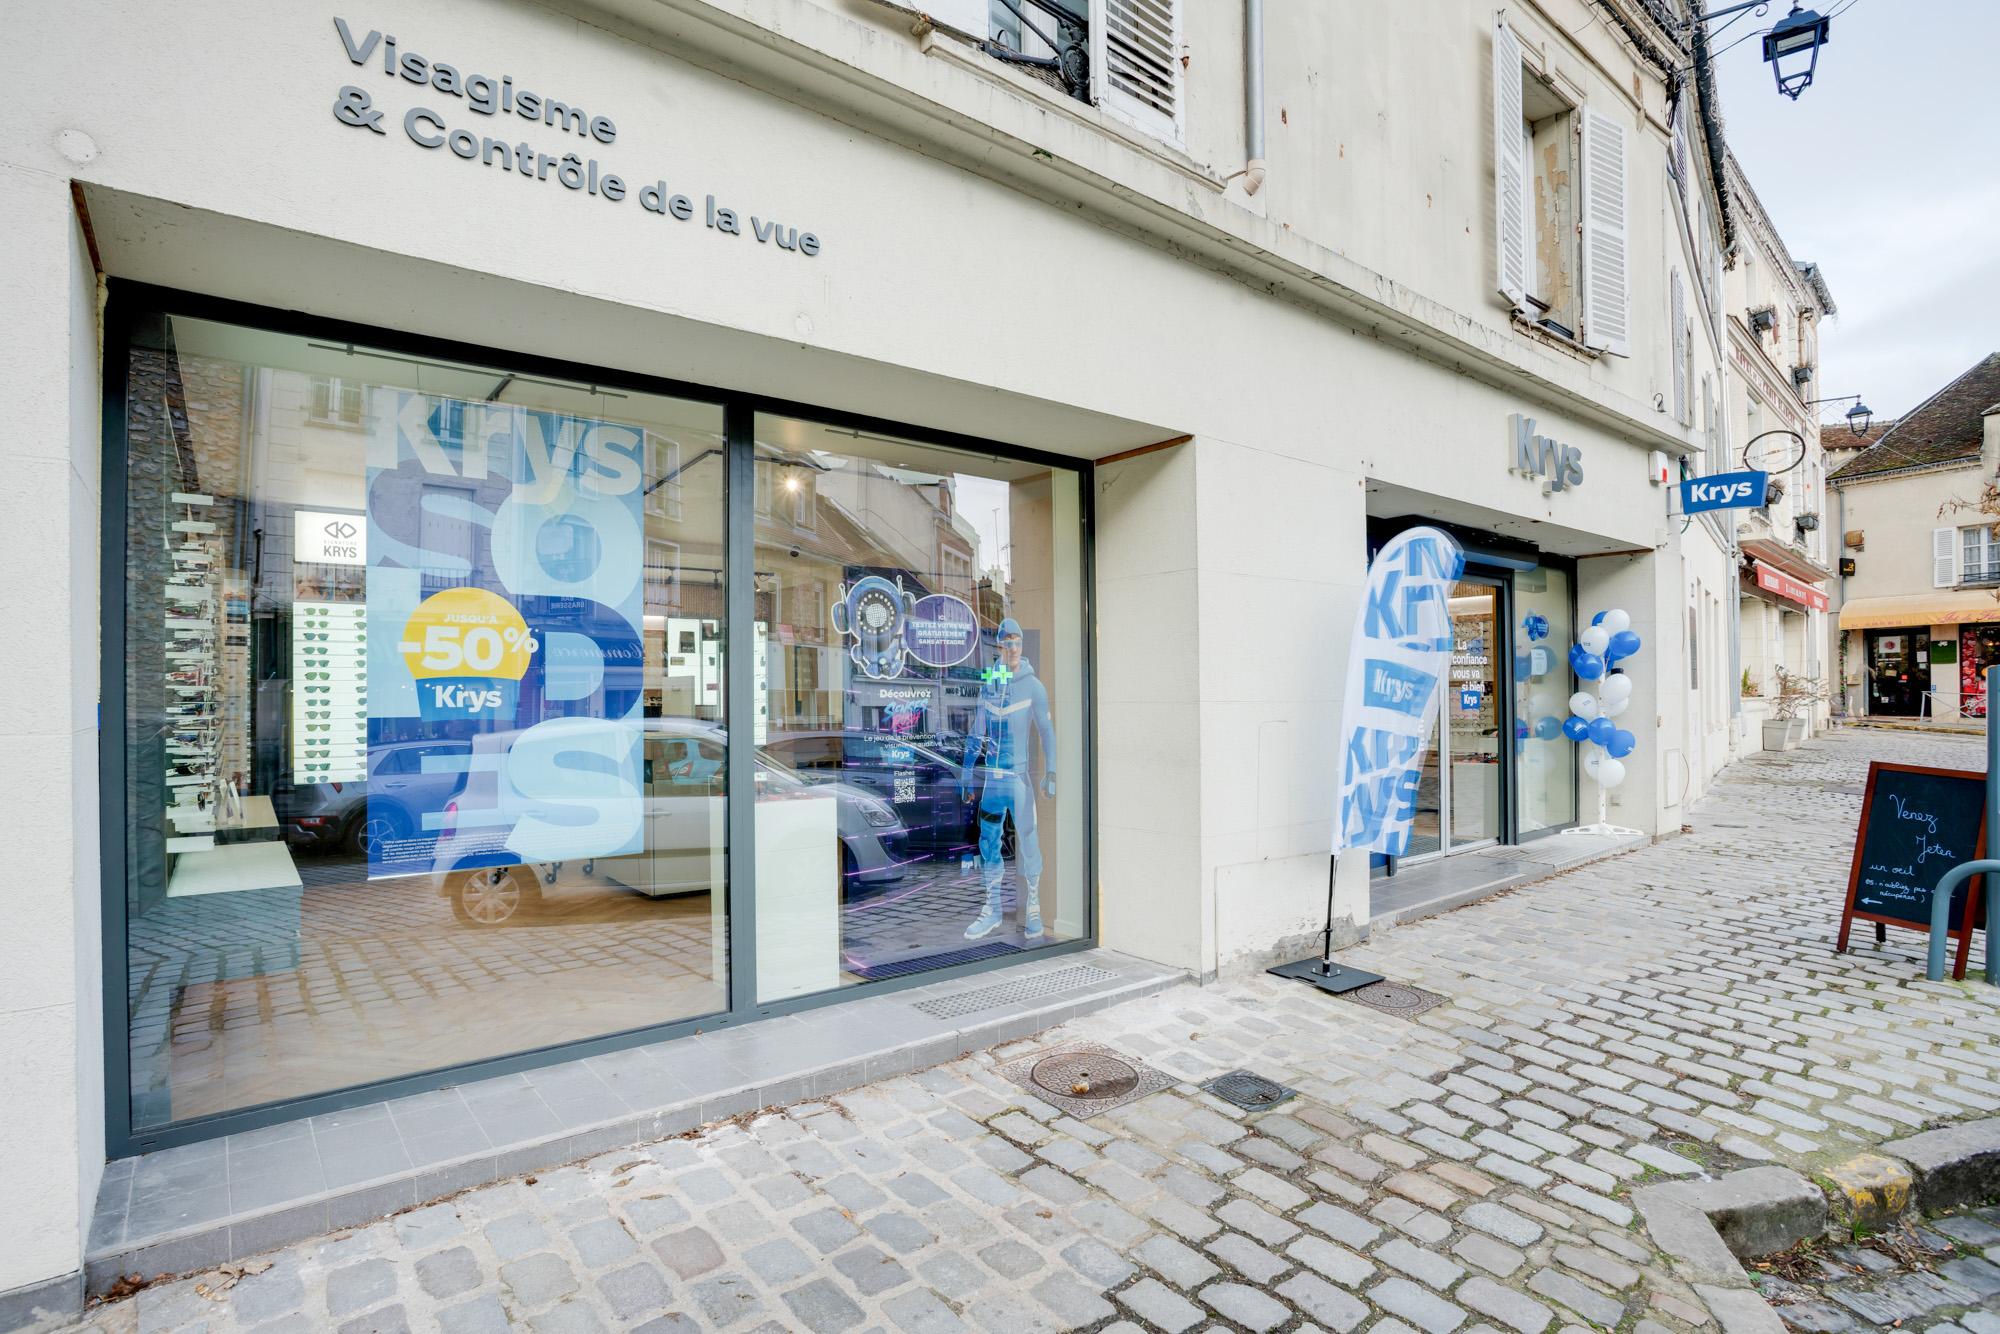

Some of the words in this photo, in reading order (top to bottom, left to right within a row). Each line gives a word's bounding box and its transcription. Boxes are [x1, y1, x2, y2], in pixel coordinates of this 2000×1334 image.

[333, 16, 617, 144] Visagisme
[333, 85, 386, 135] &
[403, 106, 626, 202] Contrôle
[639, 180, 693, 220] de
[706, 195, 740, 235] la
[751, 215, 821, 256] vue
[366, 385, 642, 504] Krys
[1508, 413, 1583, 493] Krys
[1691, 482, 1752, 504] Krys
[324, 545, 357, 558] KRYS
[1457, 638, 1467, 650] La
[1452, 653, 1488, 664] confiance
[1452, 669, 1471, 679] vous
[1472, 669, 1480, 679] va
[1462, 681, 1468, 692] si
[1470, 681, 1485, 692] bien
[435, 685, 502, 713] Krys
[879, 689, 932, 698] Découvrez
[1463, 694, 1478, 706] Krys
[892, 750, 911, 760] Krys
[1889, 794, 1938, 834] Venez
[1915, 834, 1956, 864] Jeter
[1869, 864, 1888, 873] un
